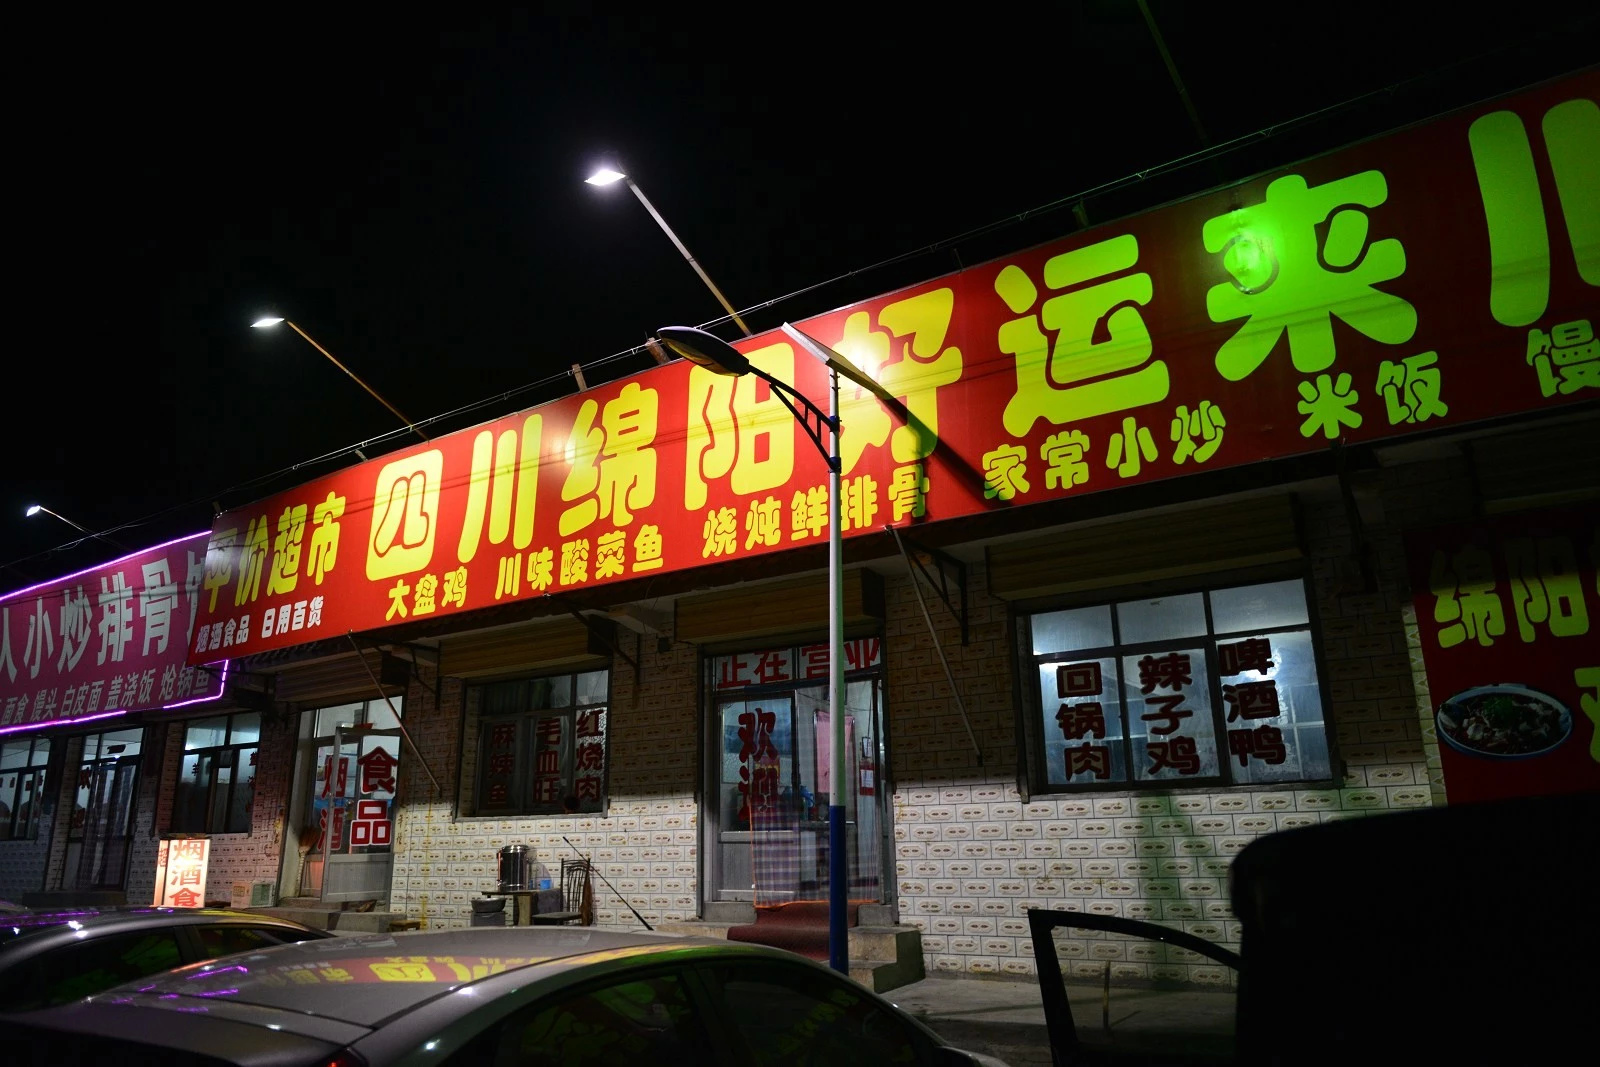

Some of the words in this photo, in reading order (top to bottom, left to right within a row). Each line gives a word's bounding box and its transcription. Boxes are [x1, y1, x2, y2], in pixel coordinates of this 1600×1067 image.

[386, 565, 468, 621] 大盘鸡
[495, 524, 664, 600] 川味酸菜鱼
[702, 463, 930, 559] 烧炖鲜排骨
[982, 400, 1226, 501] 家常小炒
[1297, 350, 1448, 439] 米饭
[1526, 320, 1600, 398] 馒
[204, 491, 346, 614] 平价超市
[1428, 535, 1600, 649] 绵阳
[195, 614, 251, 654] 烟酒食品
[261, 595, 324, 639] 日用百货
[717, 636, 881, 689] 正在营业
[30, 687, 59, 721] 馒头
[60, 679, 105, 717] 白皮面
[105, 667, 157, 711] 盖浇饭
[158, 661, 211, 702] 炝锅鱼
[1055, 662, 1111, 781] 回锅肉
[1138, 652, 1200, 775] 辣子鸡
[1217, 637, 1287, 767] 啤酒鸭
[317, 754, 349, 850] 烟酒
[350, 746, 400, 845] 食品
[487, 723, 516, 809] 麻辣鱼
[532, 718, 562, 804] 毛血旺
[575, 709, 604, 802] 红烧肉
[738, 708, 779, 821] 欢迎
